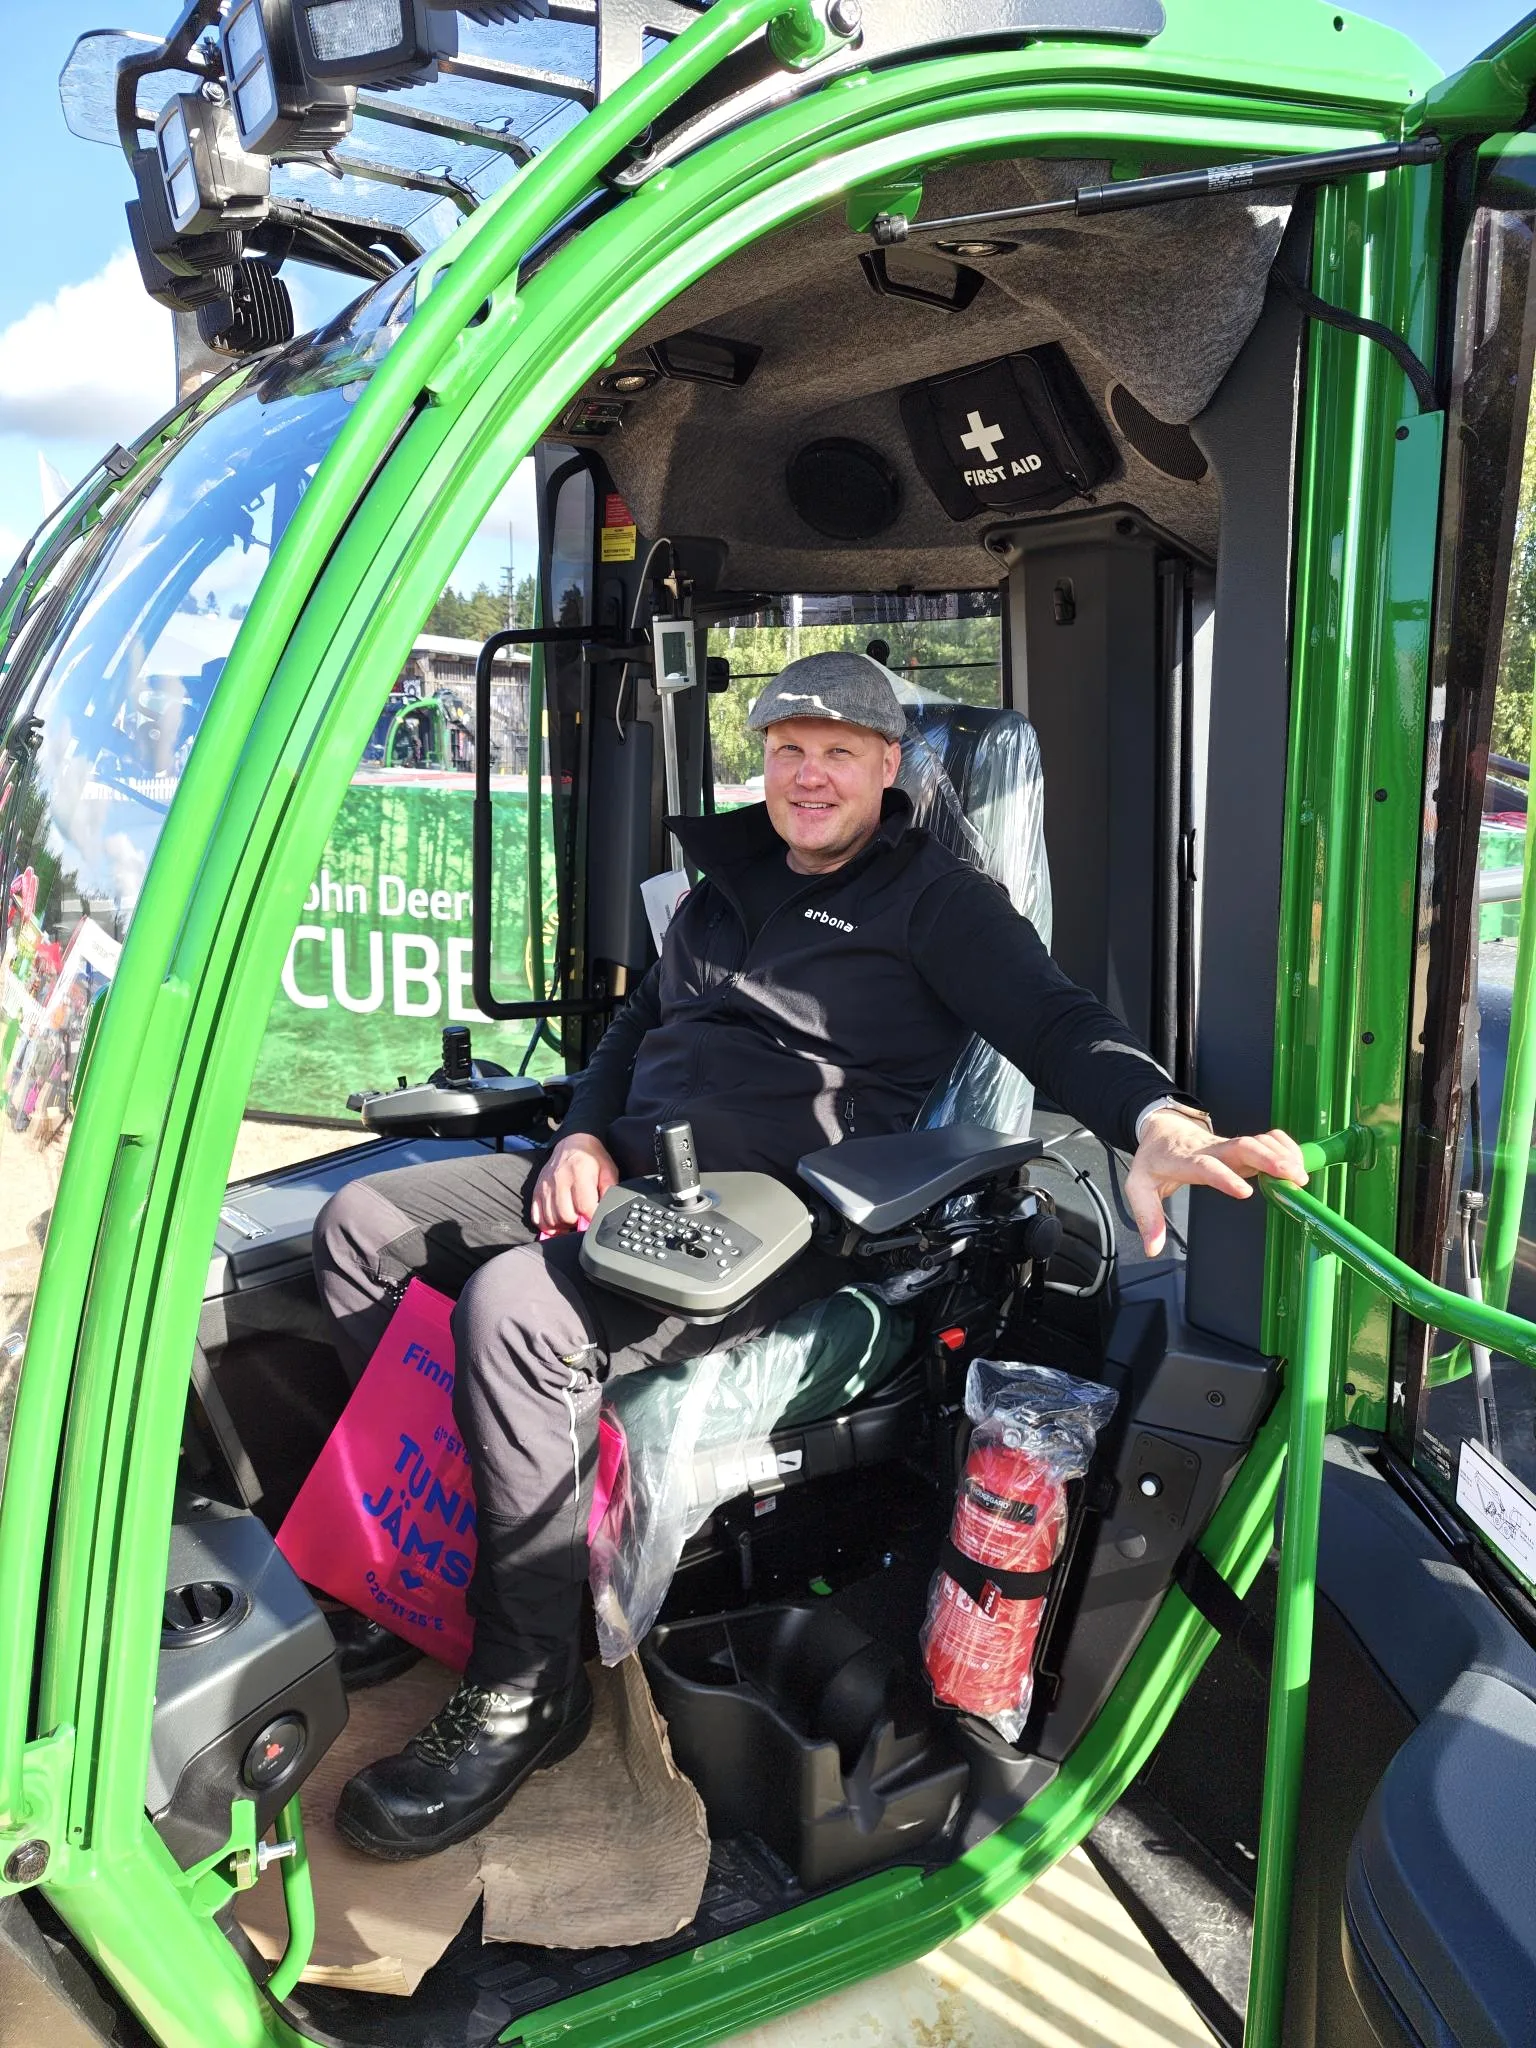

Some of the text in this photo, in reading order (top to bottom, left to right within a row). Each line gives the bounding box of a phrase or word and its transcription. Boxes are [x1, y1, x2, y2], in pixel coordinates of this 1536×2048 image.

[963, 454, 1042, 487] FIRST AID
[303, 868, 473, 921] ohn Deer
[804, 908, 854, 933] arbona
[281, 925, 494, 1023] CUBE
[402, 1342, 454, 1394] Finn
[394, 1433, 477, 1536] TUNN
[362, 1486, 472, 1588] JÄMS
[984, 1590, 996, 1614] PULL
